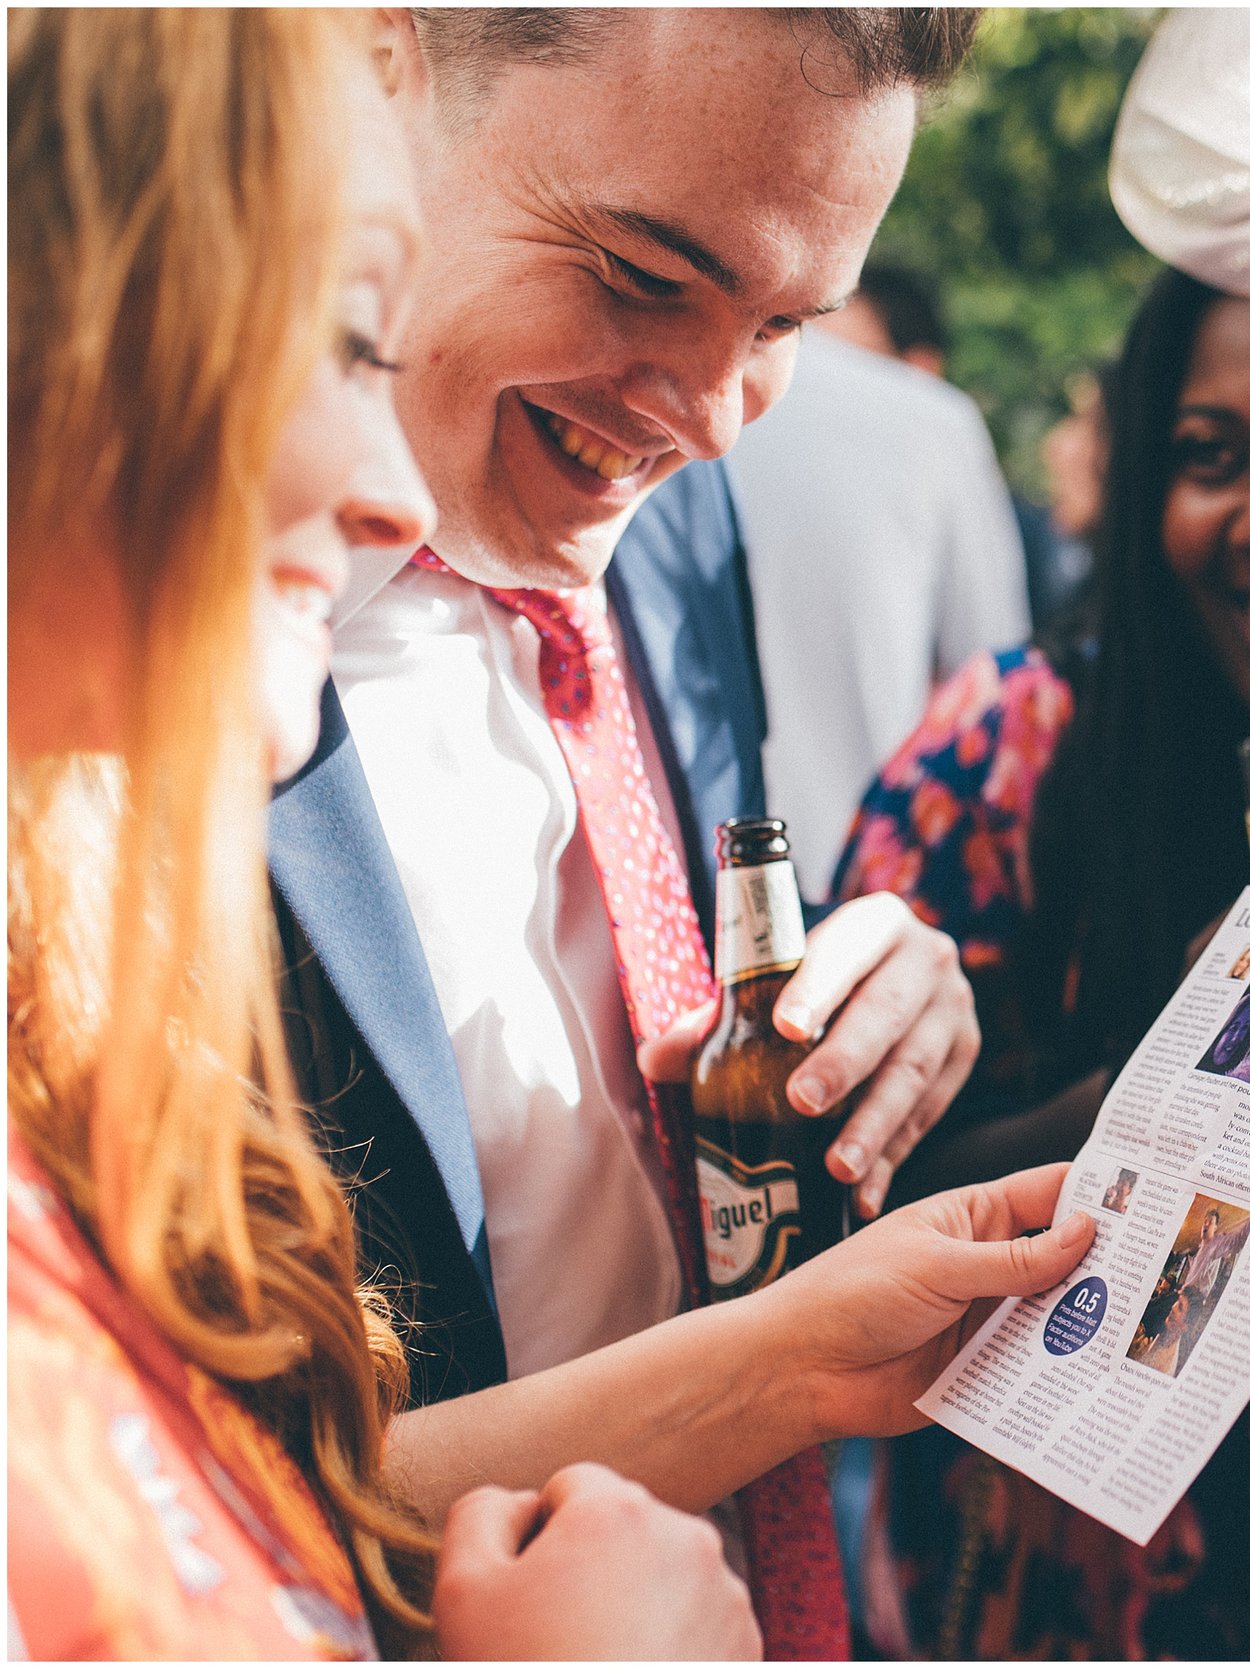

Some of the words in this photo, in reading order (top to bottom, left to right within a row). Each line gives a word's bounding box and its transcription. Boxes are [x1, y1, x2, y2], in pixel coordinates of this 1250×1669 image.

[1223, 1131, 1234, 1139] ket
[1223, 1145, 1244, 1154] cocktail
[1205, 1160, 1217, 1168] there
[1199, 1169, 1218, 1179] South
[1216, 1175, 1235, 1185] African
[1073, 1288, 1101, 1313] 0.5
[1059, 1303, 1071, 1314] Pints
[1071, 1308, 1086, 1320] before
[1086, 1315, 1097, 1325] Matt
[1053, 1314, 1072, 1326] subjects
[1071, 1323, 1081, 1331] you
[1047, 1322, 1063, 1335] Factor
[1062, 1332, 1083, 1344] auditions
[1053, 1337, 1072, 1351] YouTube
